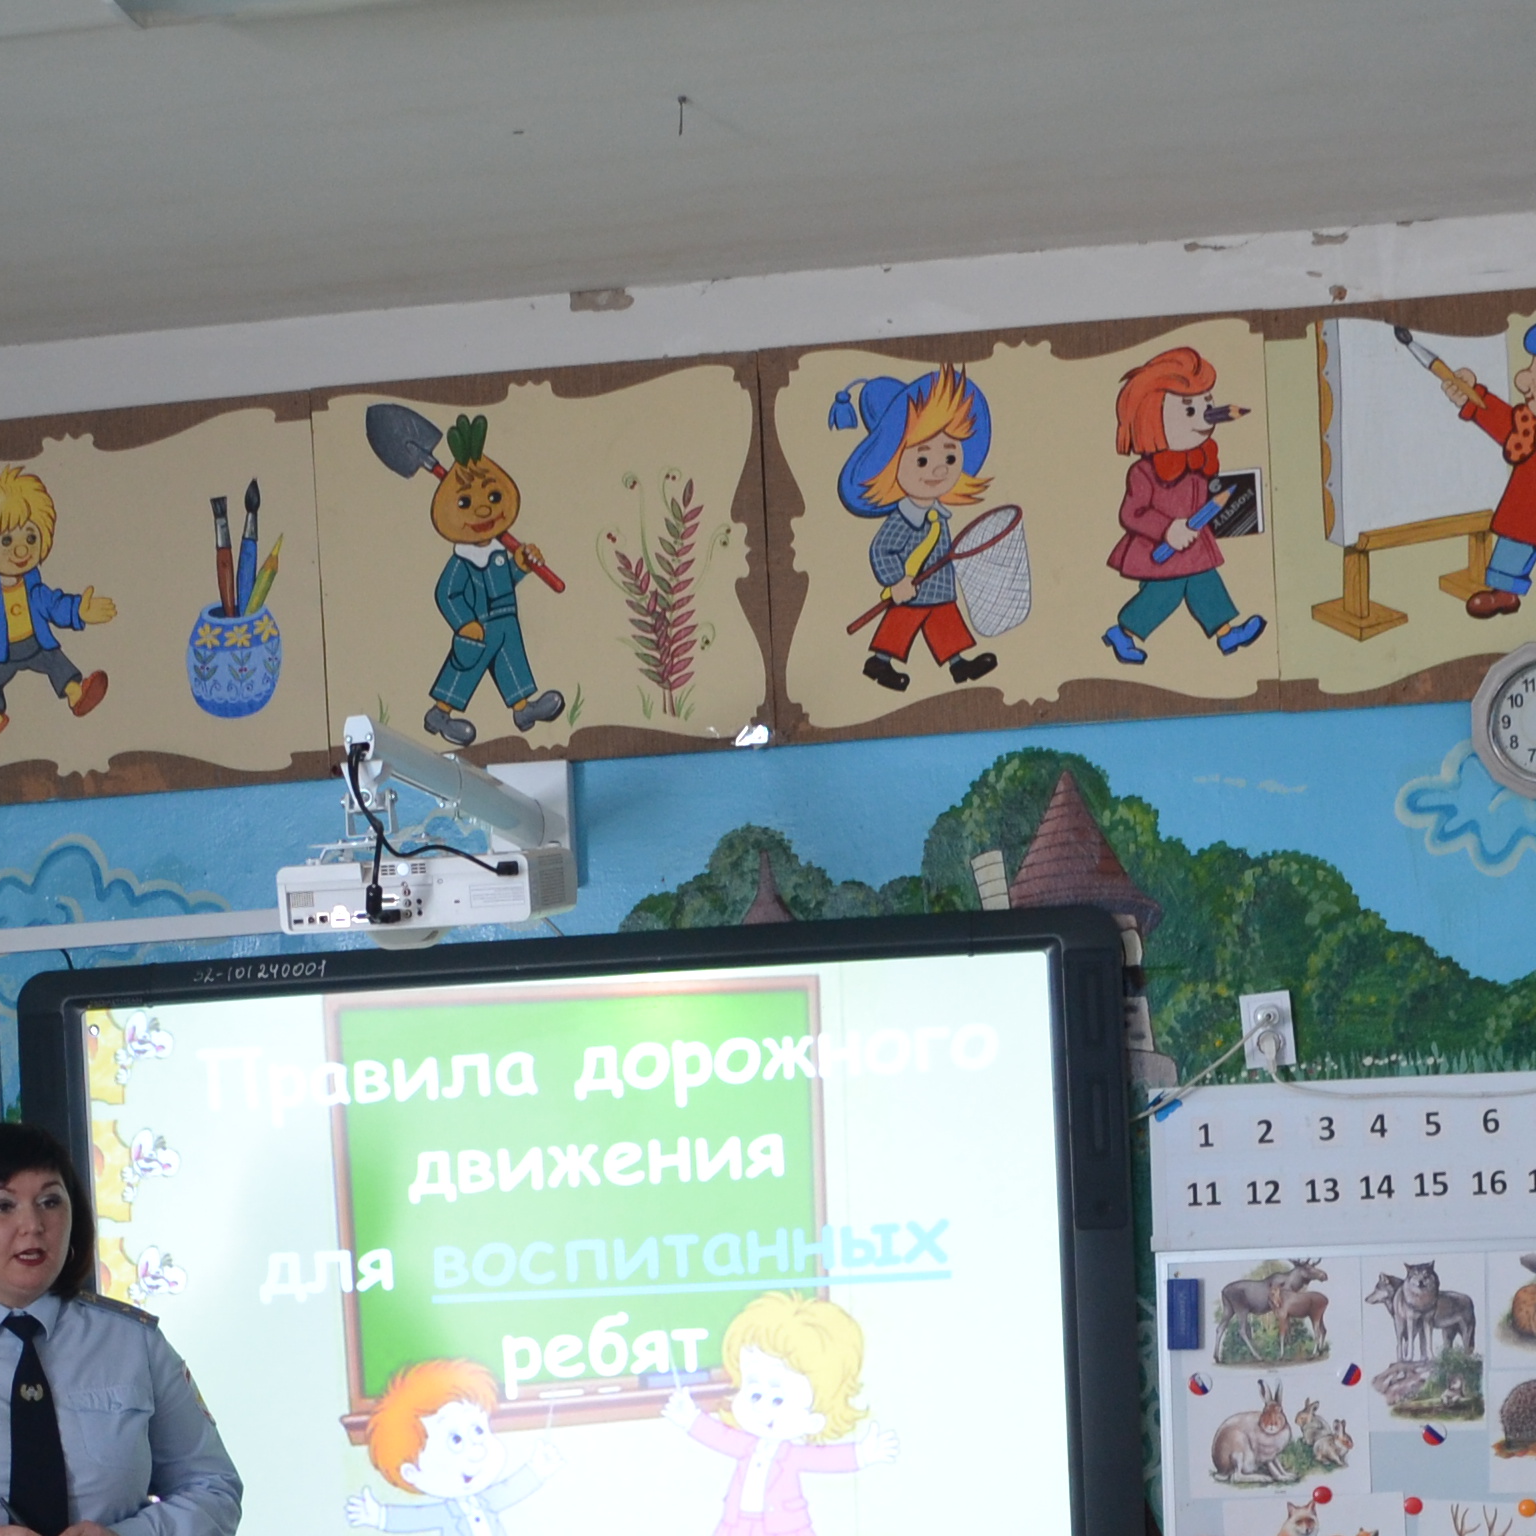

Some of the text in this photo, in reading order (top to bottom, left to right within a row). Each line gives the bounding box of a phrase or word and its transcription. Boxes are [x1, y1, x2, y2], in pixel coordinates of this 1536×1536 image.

[1508, 694, 1524, 708] 10
[1523, 678, 1536, 693] 11
[1501, 715, 1511, 729] 9
[1510, 735, 1519, 749] 8
[1528, 749, 1536, 763] 7
[197, 1023, 1001, 1128] Правила дорожного
[1198, 1123, 1214, 1148] 1
[1257, 1119, 1274, 1144] 2
[1319, 1116, 1335, 1141] 3
[1370, 1114, 1388, 1138] 4
[1425, 1112, 1441, 1136] 5
[1482, 1108, 1500, 1134] 6
[408, 1133, 786, 1204] движения
[1187, 1181, 1222, 1207] 11
[1247, 1180, 1281, 1205] 12
[1305, 1178, 1340, 1203] 13
[1360, 1174, 1395, 1200] 14
[1414, 1171, 1449, 1197] 15
[1472, 1170, 1507, 1196] 16
[259, 1218, 951, 1304] для воспитанных
[501, 1312, 710, 1401] ребят
